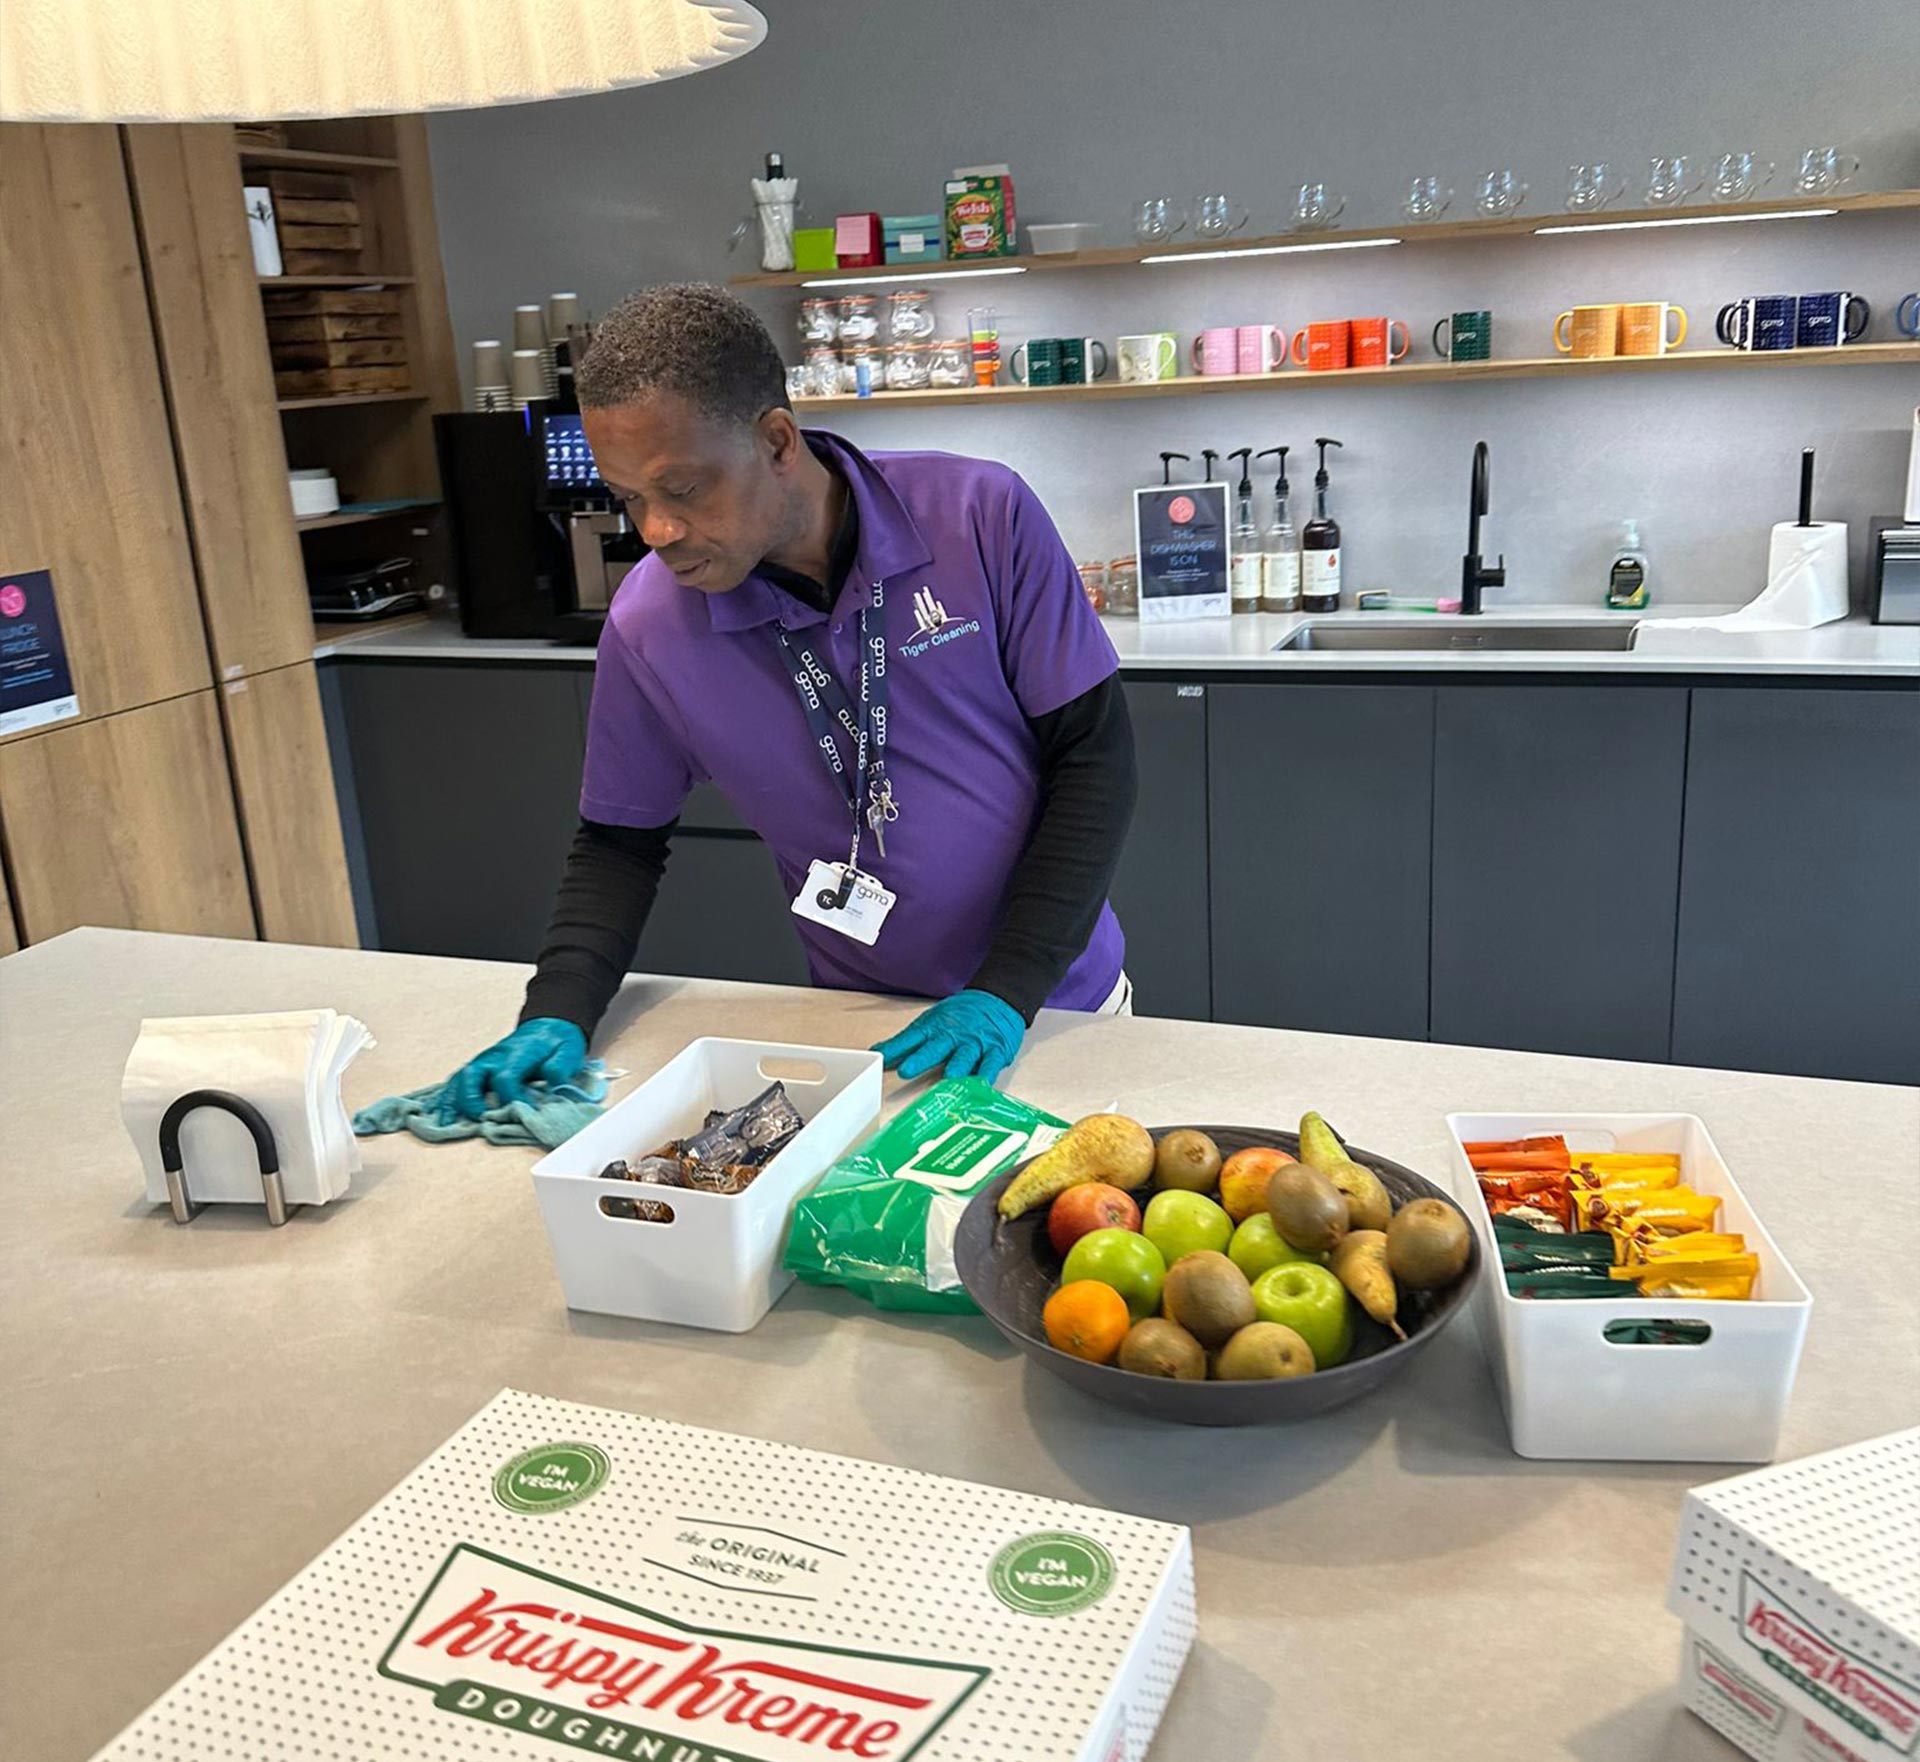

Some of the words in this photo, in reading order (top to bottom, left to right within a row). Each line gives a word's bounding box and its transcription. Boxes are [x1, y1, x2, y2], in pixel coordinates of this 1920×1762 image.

[898, 641, 930, 657] Tiger
[931, 620, 981, 646] Cleaning
[518, 1472, 580, 1493] VEGAN
[687, 1553, 745, 1577] SINCE
[709, 1536, 820, 1574] ORIGINAL
[1014, 1570, 1089, 1588] VEGAN
[413, 1587, 694, 1709] Krispy
[638, 1644, 935, 1758] Kreme
[456, 1687, 734, 1762] DOUGHNU
